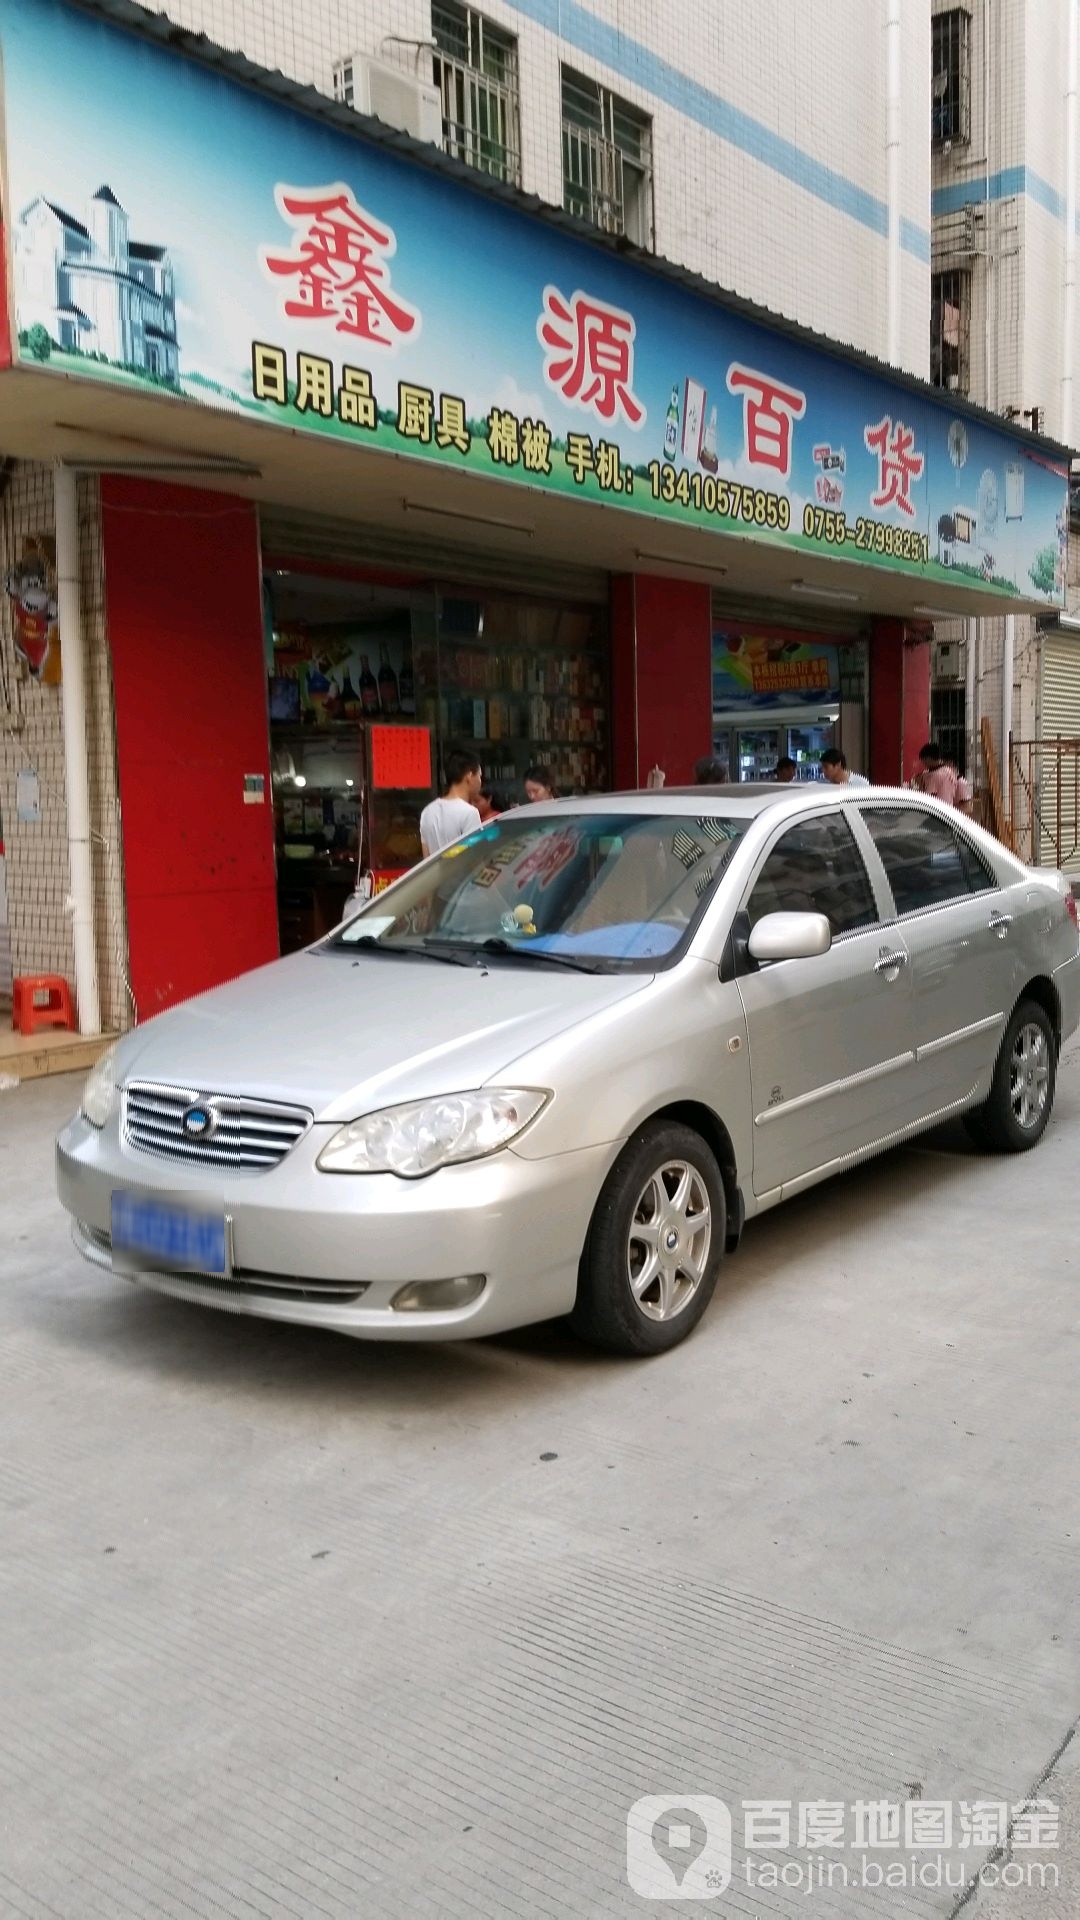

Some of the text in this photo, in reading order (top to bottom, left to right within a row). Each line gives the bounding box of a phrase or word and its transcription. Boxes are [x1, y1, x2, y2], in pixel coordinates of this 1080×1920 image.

[252, 341, 376, 429] 日用品
[398, 381, 471, 453] 厨具
[487, 408, 552, 475] 棉被
[648, 462, 790, 530] 13410575859
[803, 503, 929, 564] 0755-27998251
[262, 186, 926, 517] 鑫源百货
